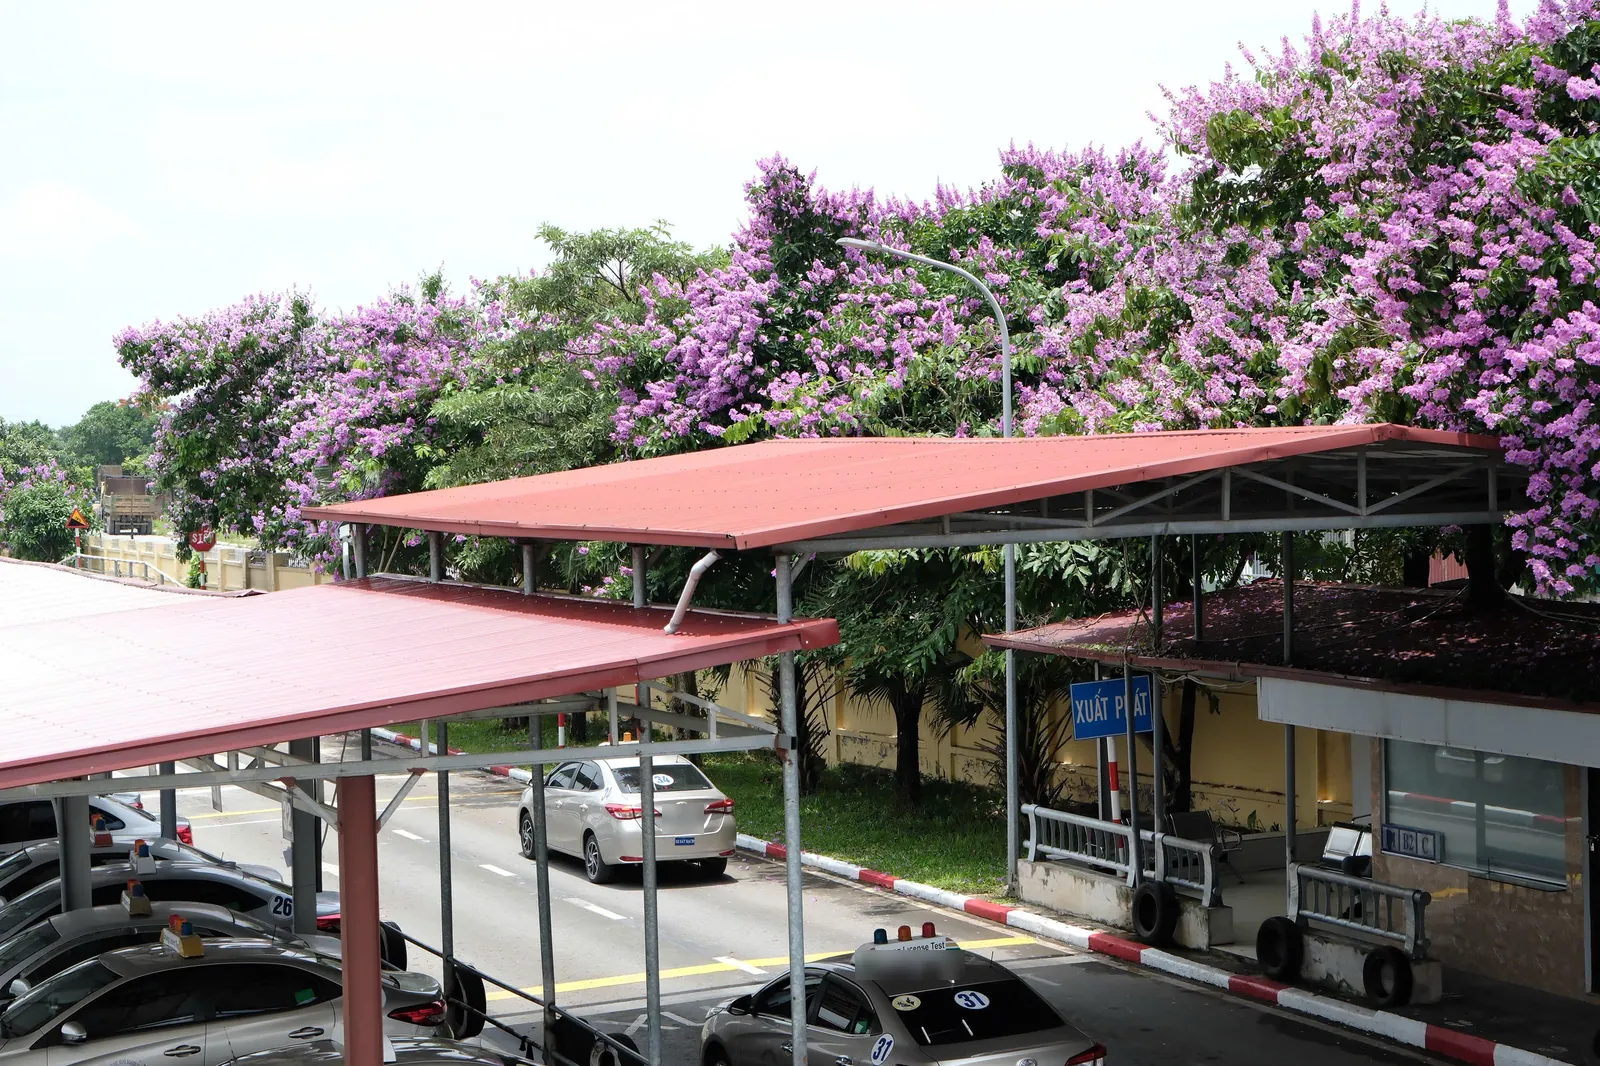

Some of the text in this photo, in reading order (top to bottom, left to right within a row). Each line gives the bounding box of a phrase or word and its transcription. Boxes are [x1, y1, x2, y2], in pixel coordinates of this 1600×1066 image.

[1076, 688, 1148, 724] XUẤT PÁT
[654, 775, 671, 784] 34
[1403, 832, 1414, 851] B2
[1422, 836, 1429, 855] C
[272, 895, 293, 917] 26
[930, 941, 945, 950] Test
[957, 991, 986, 1008] 31
[872, 1037, 893, 1062] 31
